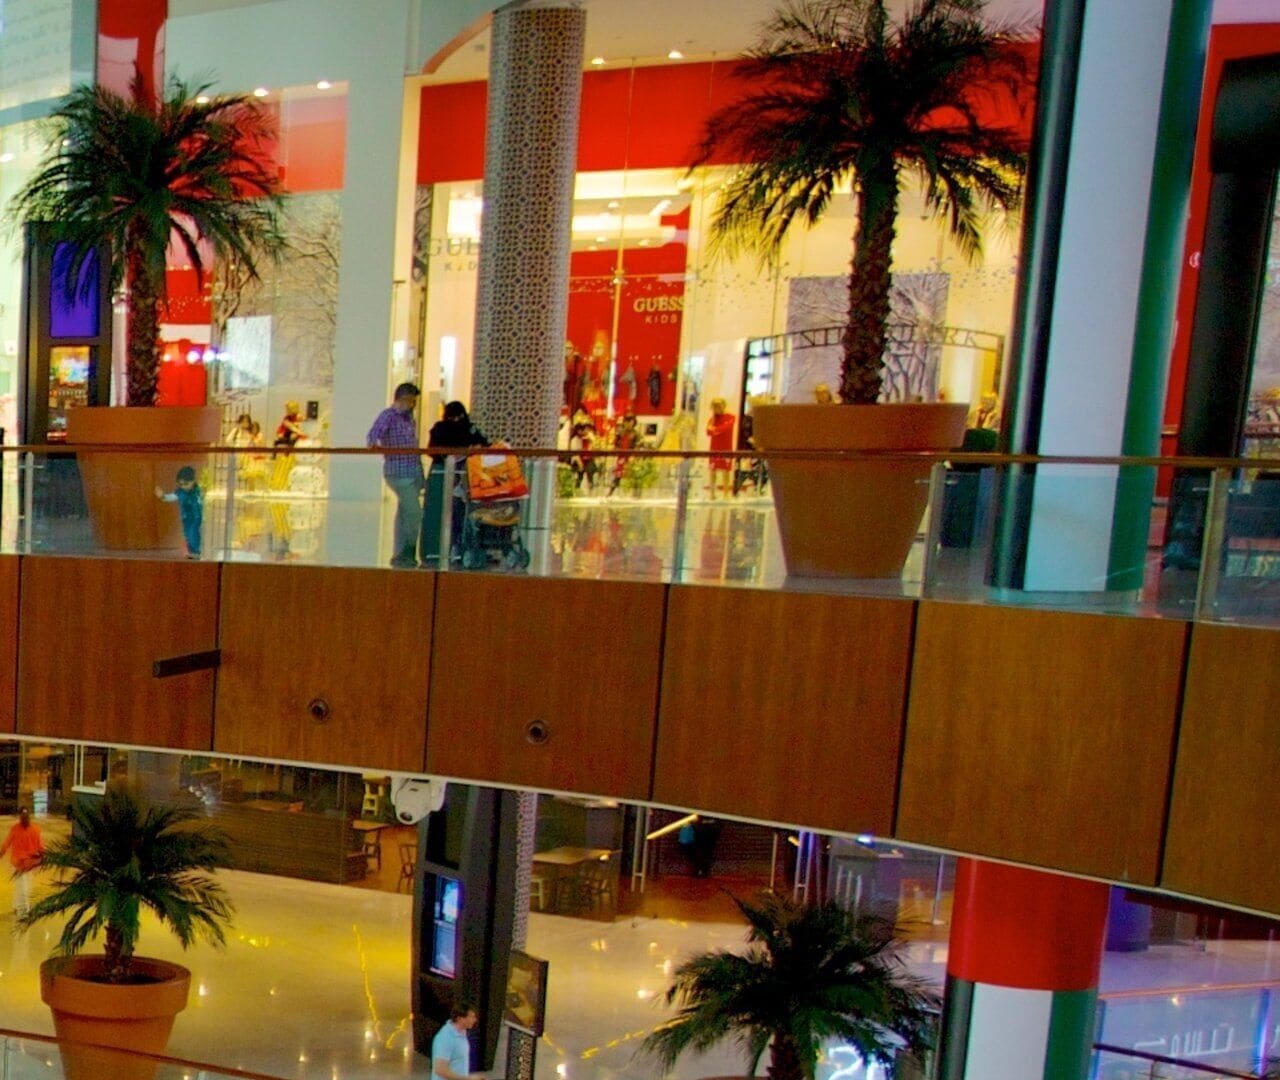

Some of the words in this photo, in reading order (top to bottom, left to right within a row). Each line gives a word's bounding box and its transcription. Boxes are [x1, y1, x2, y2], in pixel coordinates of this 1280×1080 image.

[428, 237, 481, 257] GUE
[633, 296, 686, 312] GUESS
[645, 314, 678, 324] KIDS
